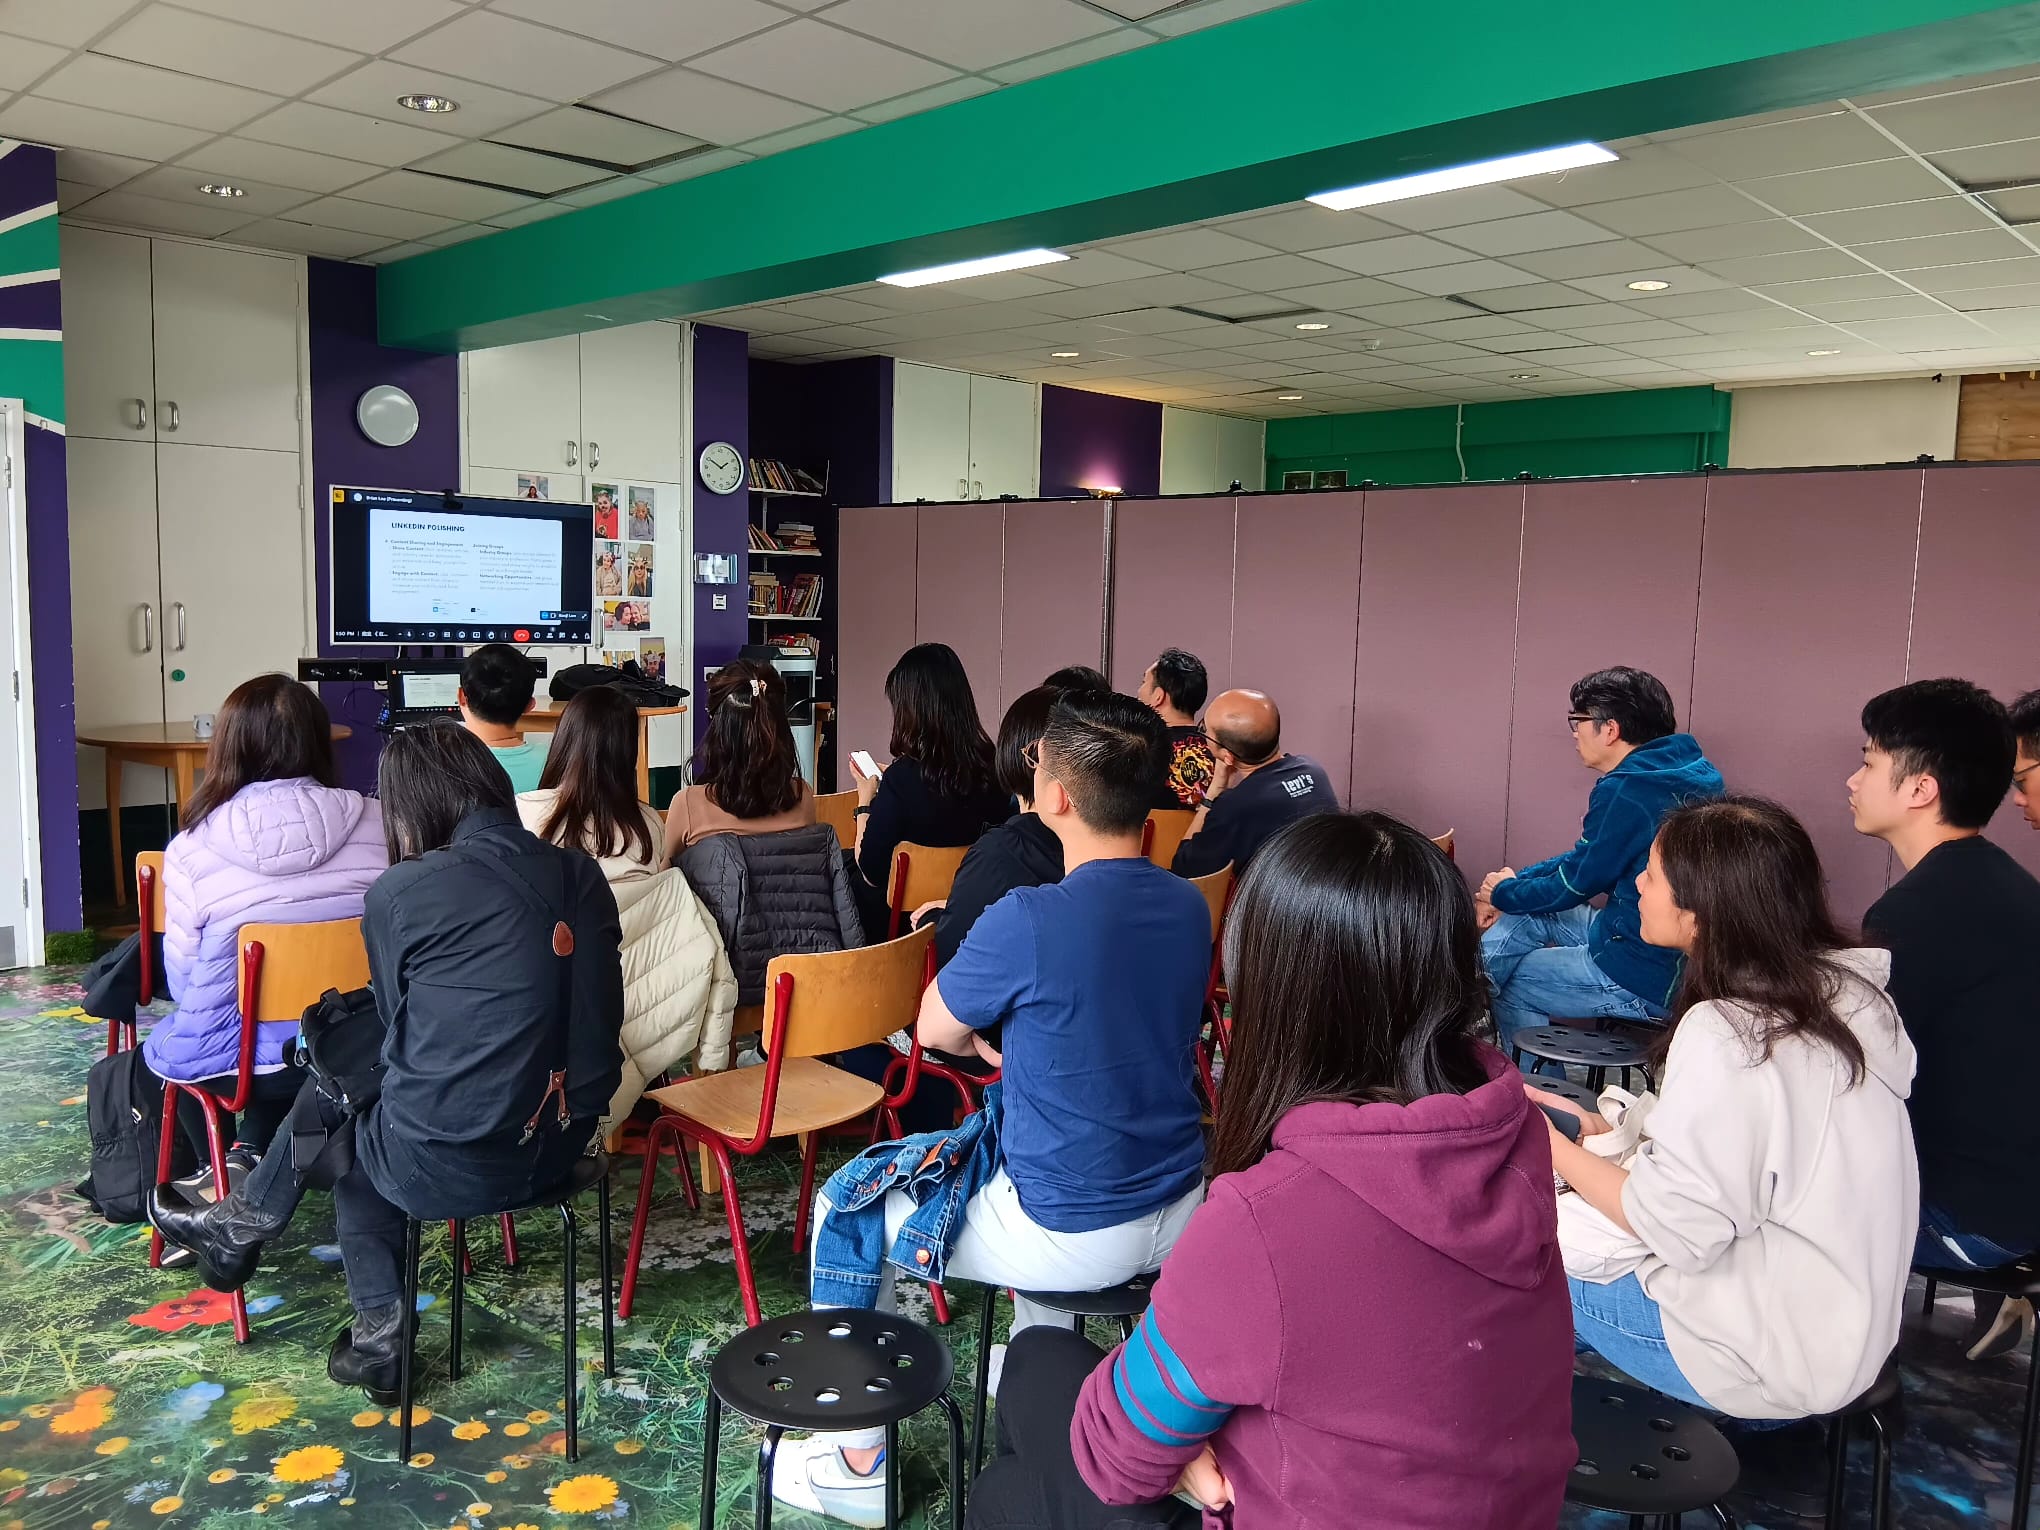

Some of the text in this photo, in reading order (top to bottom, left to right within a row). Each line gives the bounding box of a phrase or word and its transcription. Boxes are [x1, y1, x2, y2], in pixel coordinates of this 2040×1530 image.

[391, 522, 465, 532] LINKEDIN POLISHING
[1281, 774, 1314, 793] levi's
